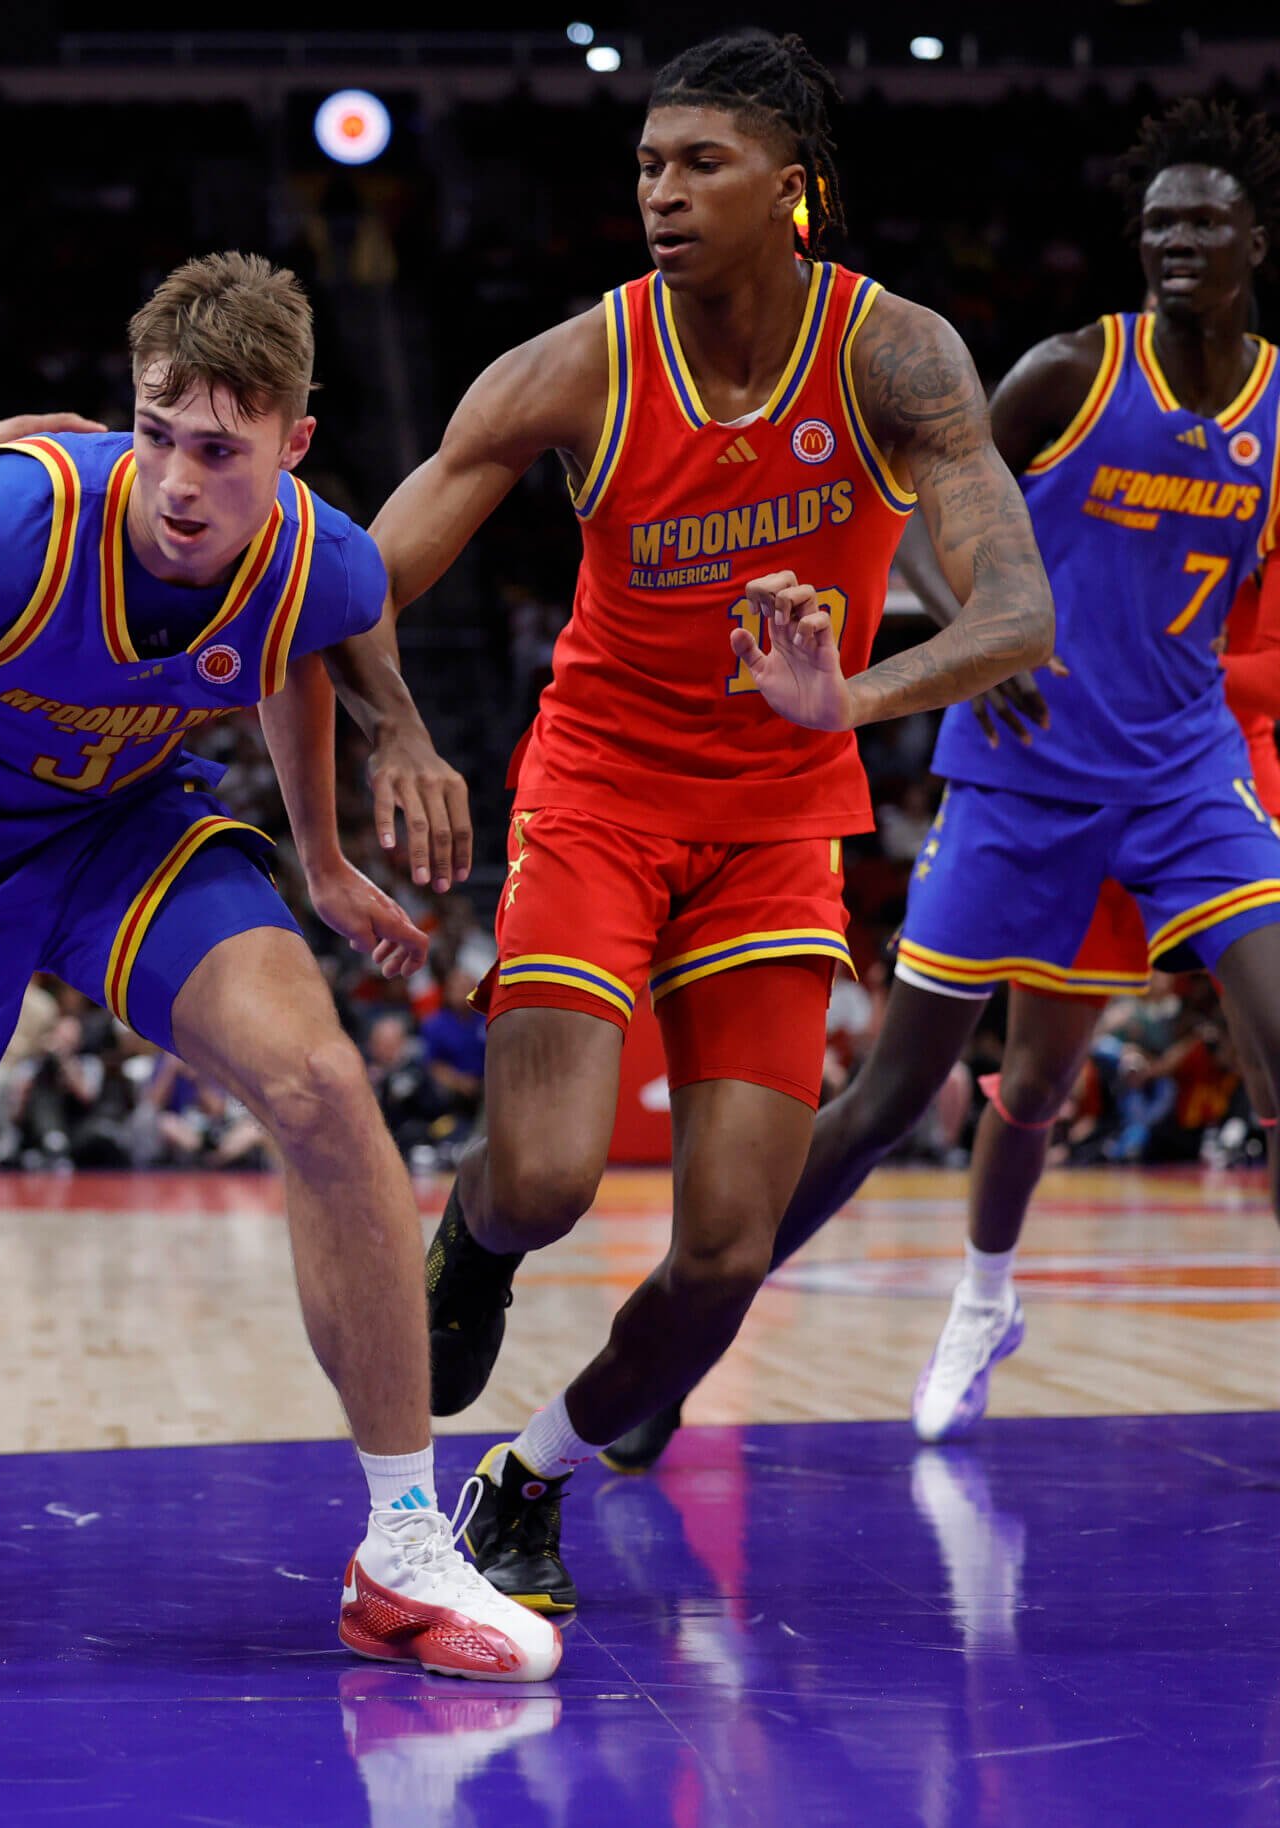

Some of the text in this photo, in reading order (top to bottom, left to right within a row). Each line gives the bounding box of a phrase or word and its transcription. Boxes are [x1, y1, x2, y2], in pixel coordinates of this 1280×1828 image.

[629, 560, 732, 588] ALL AMERICAN
[1164, 550, 1231, 636] 7
